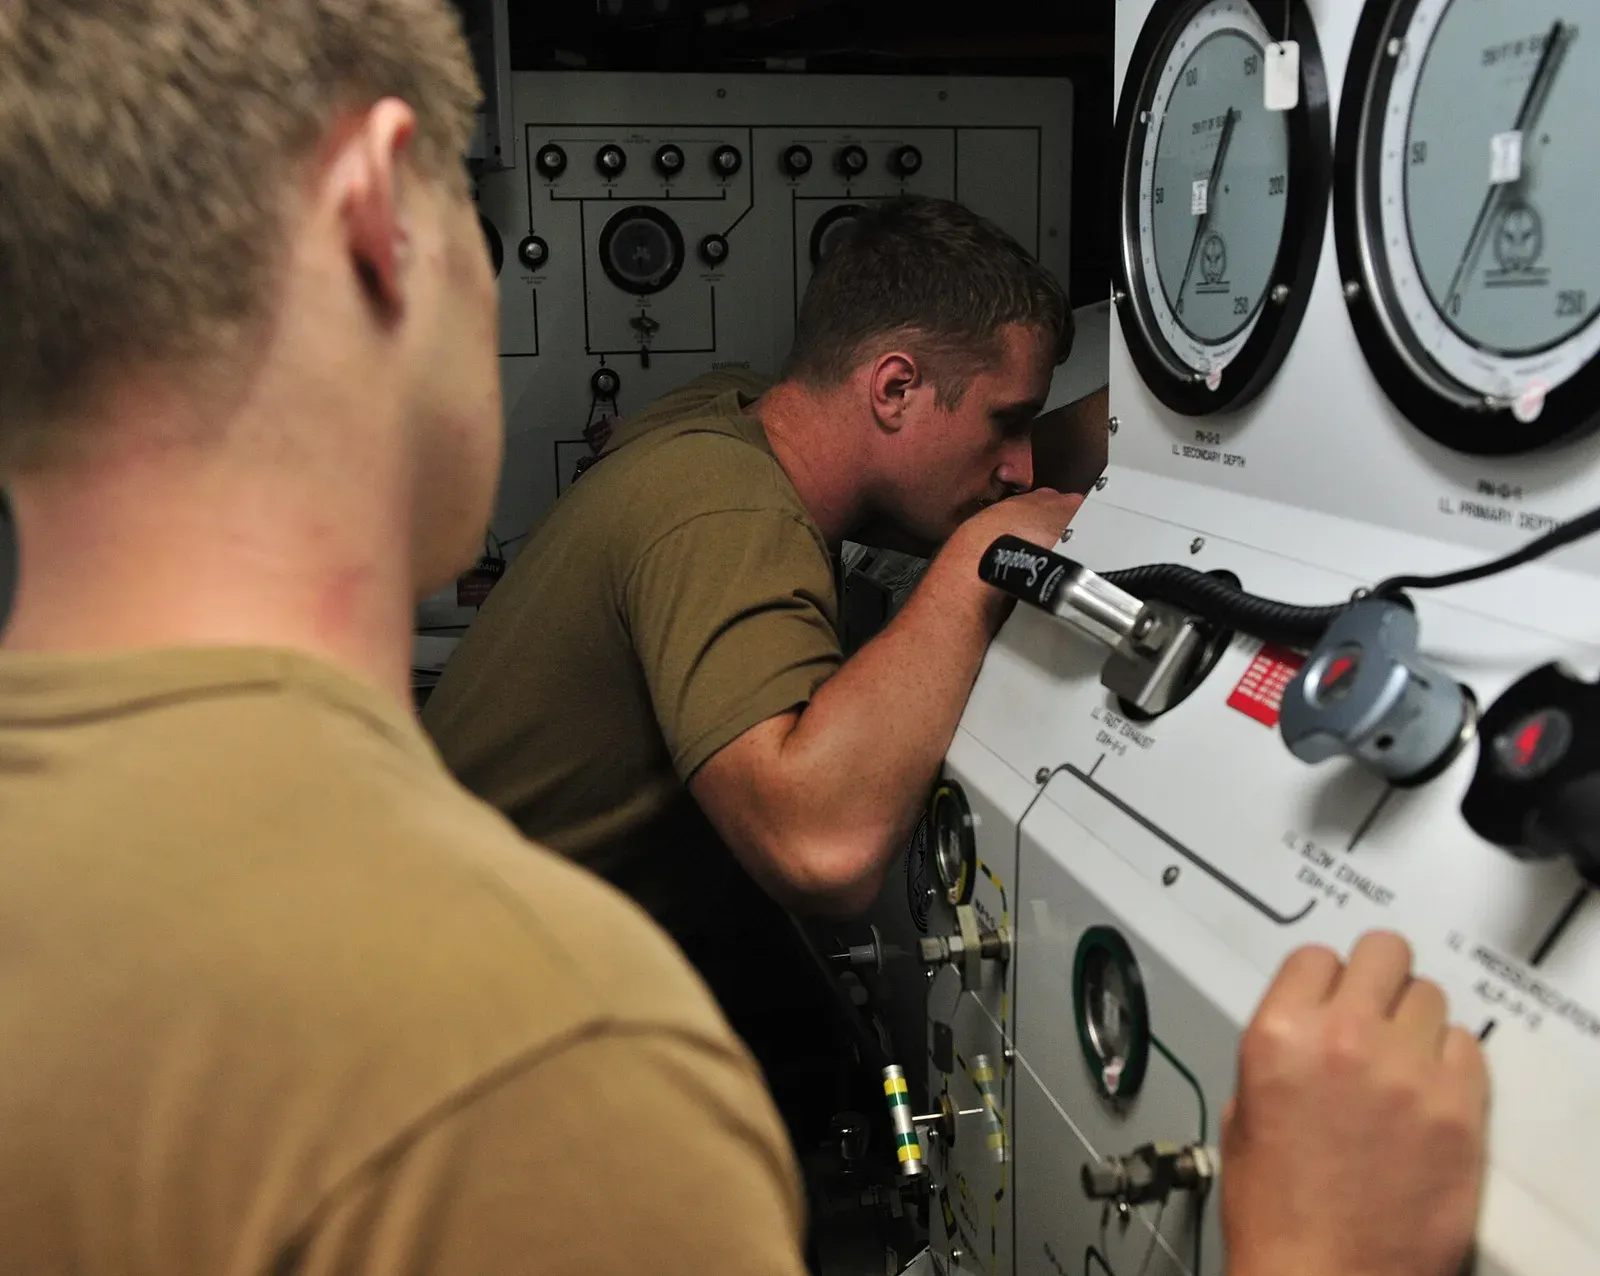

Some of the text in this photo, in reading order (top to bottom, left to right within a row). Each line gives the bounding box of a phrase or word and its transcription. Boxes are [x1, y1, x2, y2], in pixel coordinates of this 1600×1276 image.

[1244, 54, 1258, 76] 150
[1185, 67, 1199, 87] 100
[1411, 141, 1427, 165] 50
[1155, 187, 1165, 204] 50
[1268, 175, 1285, 196] 200
[1233, 296, 1248, 315] 250
[1555, 289, 1586, 317] 250
[1182, 445, 1221, 462] SECONDARY
[1223, 453, 1247, 468] DEPTH
[1460, 499, 1513, 524] PRIMARY
